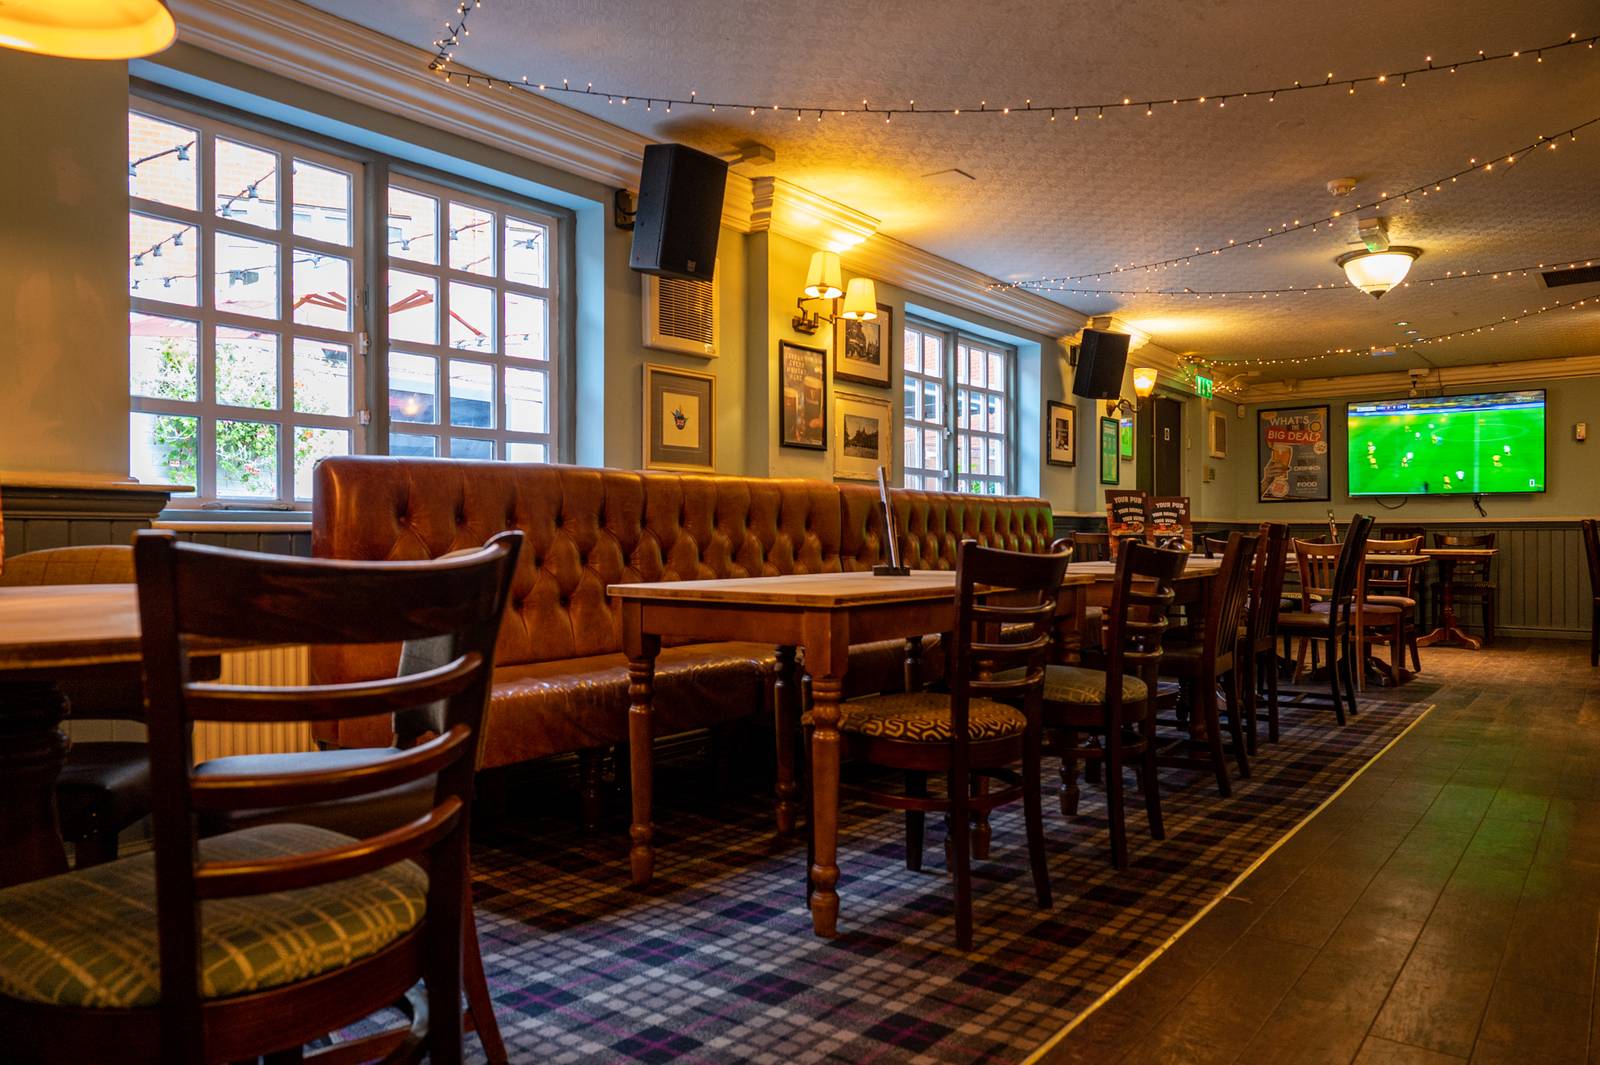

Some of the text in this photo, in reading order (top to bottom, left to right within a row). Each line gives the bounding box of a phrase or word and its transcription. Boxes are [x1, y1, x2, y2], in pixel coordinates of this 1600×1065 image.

[1270, 415, 1310, 426] WHAT'S
[1268, 430, 1321, 442] BIG DEAL?
[1113, 496, 1142, 504] YOUR PUB
